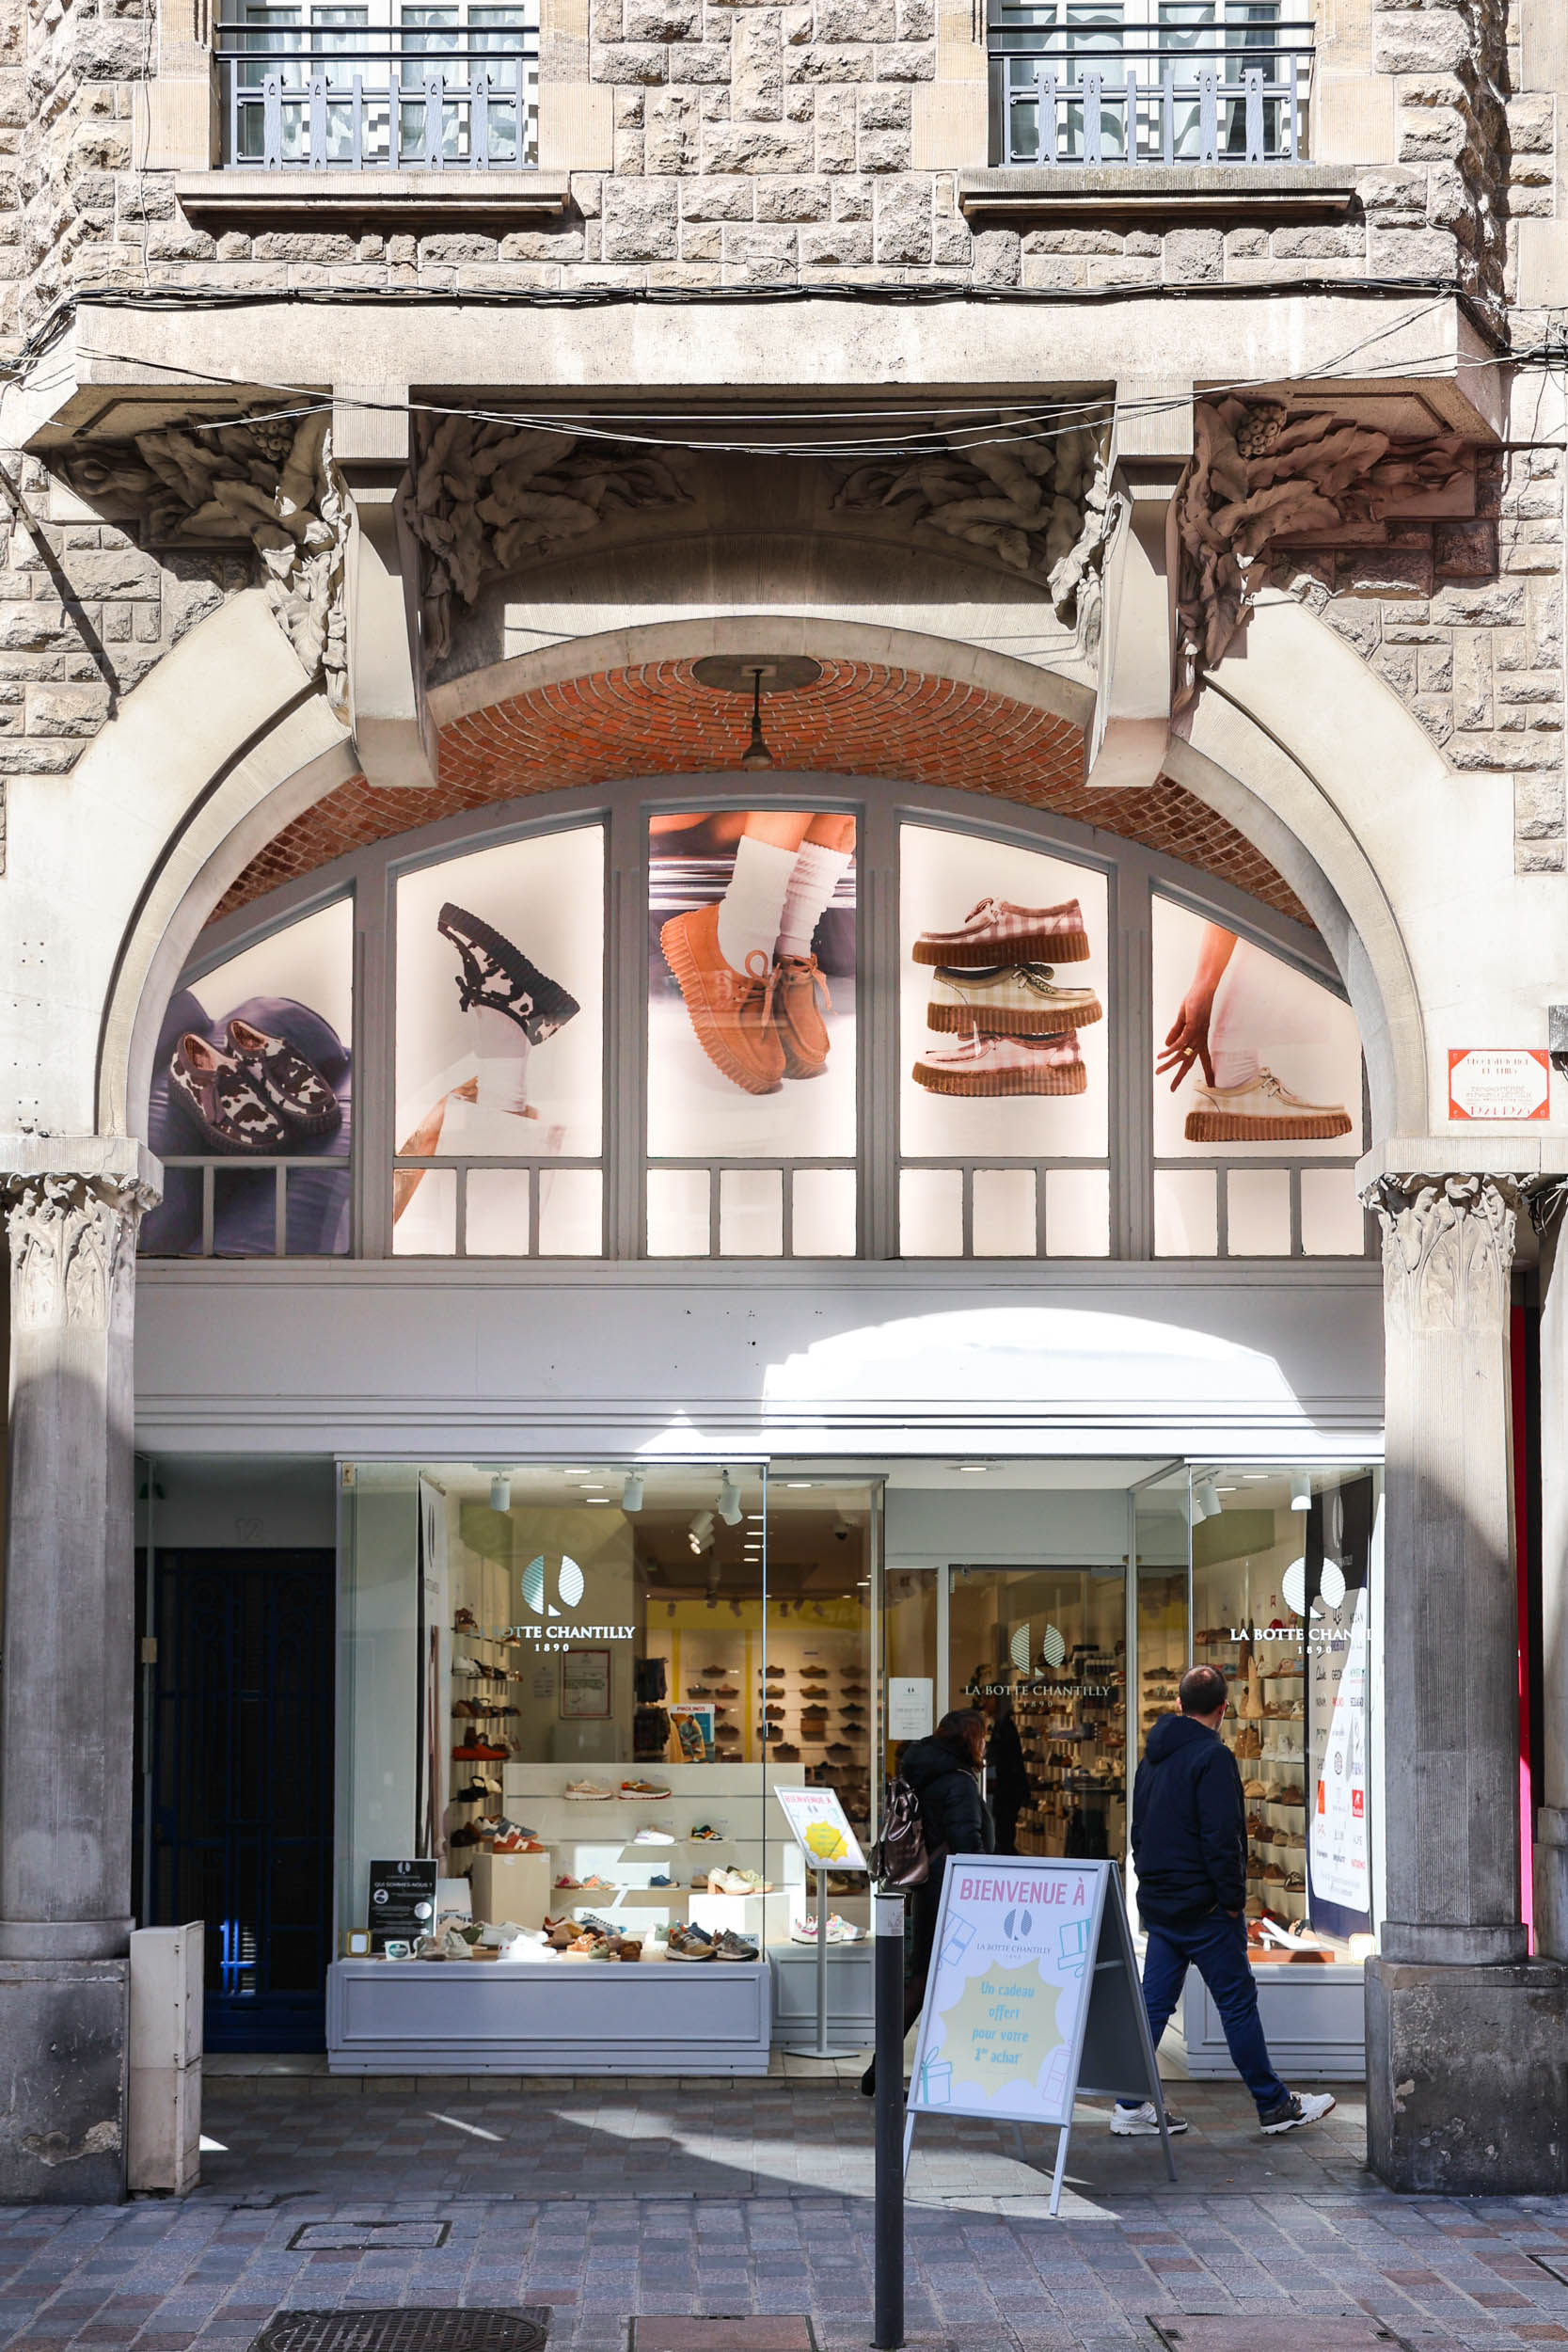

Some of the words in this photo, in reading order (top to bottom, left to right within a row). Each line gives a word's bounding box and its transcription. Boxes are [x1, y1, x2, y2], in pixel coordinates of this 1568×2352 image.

[546, 1626, 636, 1639] CHANTILLY
[1230, 1629, 1250, 1642] LA
[1254, 1629, 1305, 1642] BOTTE
[534, 1643, 570, 1652] 1890
[1297, 1645, 1332, 1655] 1890
[965, 1685, 982, 1696] LA
[985, 1685, 1029, 1696] BOTTE
[1032, 1685, 1112, 1696] CHANTILLY
[959, 1878, 1069, 1905] BIENVENUE
[1072, 1876, 1085, 1906] À
[987, 1943, 1009, 1952] BOTTE
[1011, 1945, 1053, 1955] CHANTILLY
[980, 1980, 995, 1995] Un
[998, 1983, 1036, 1998] cadeau
[988, 2004, 1022, 2021] offert
[972, 2028, 997, 2042] pour
[1000, 2031, 1030, 2042] votre
